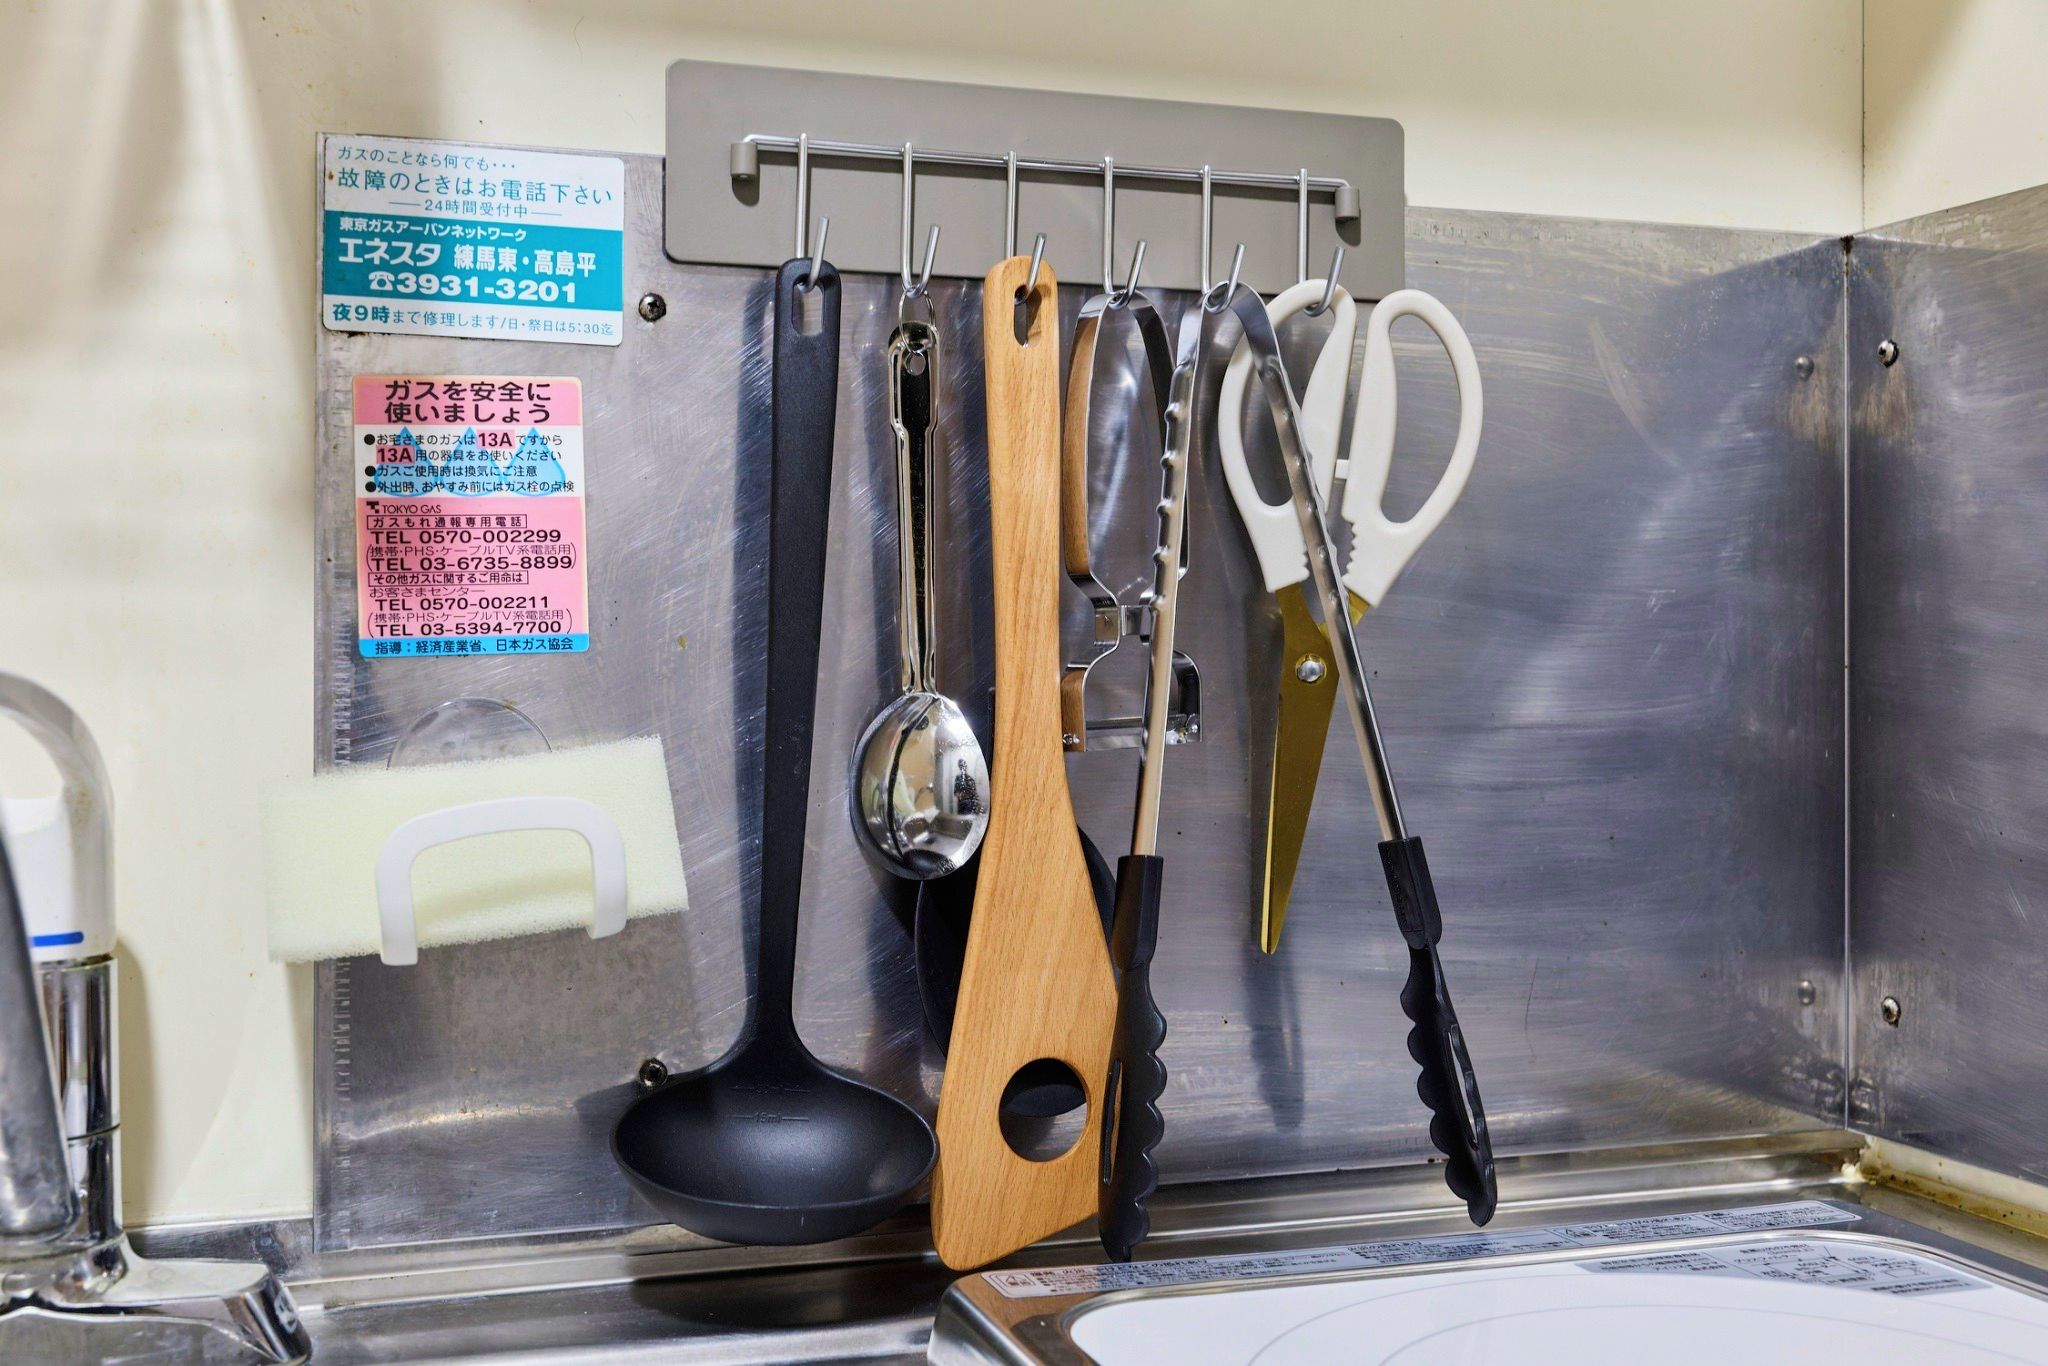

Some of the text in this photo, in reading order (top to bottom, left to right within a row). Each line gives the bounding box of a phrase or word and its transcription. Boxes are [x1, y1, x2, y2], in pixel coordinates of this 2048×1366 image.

[338, 167, 612, 205] 故障のときはお電話下さい
[424, 199, 528, 218] 24時間受付中
[339, 217, 527, 242] 東京ガスアーバンネットワーク
[339, 237, 597, 278] エネスタ 練馬東・高島平
[396, 274, 576, 303] 3931-3201
[385, 380, 552, 403] ガスを安全に
[384, 403, 551, 424] 使いましょう
[382, 504, 442, 514] TOKYO GAS
[373, 516, 522, 528] ガスもれ通報専用電話
[371, 529, 561, 545] TEL 0570-002299
[371, 555, 573, 572] TEL 03-6735-8899
[373, 572, 523, 585] その他ガスに関するご用命は
[369, 587, 486, 598] お客さまセンター
[375, 596, 549, 611] TEL 0570-002211
[376, 621, 561, 636] TEL 03-5394-7700
